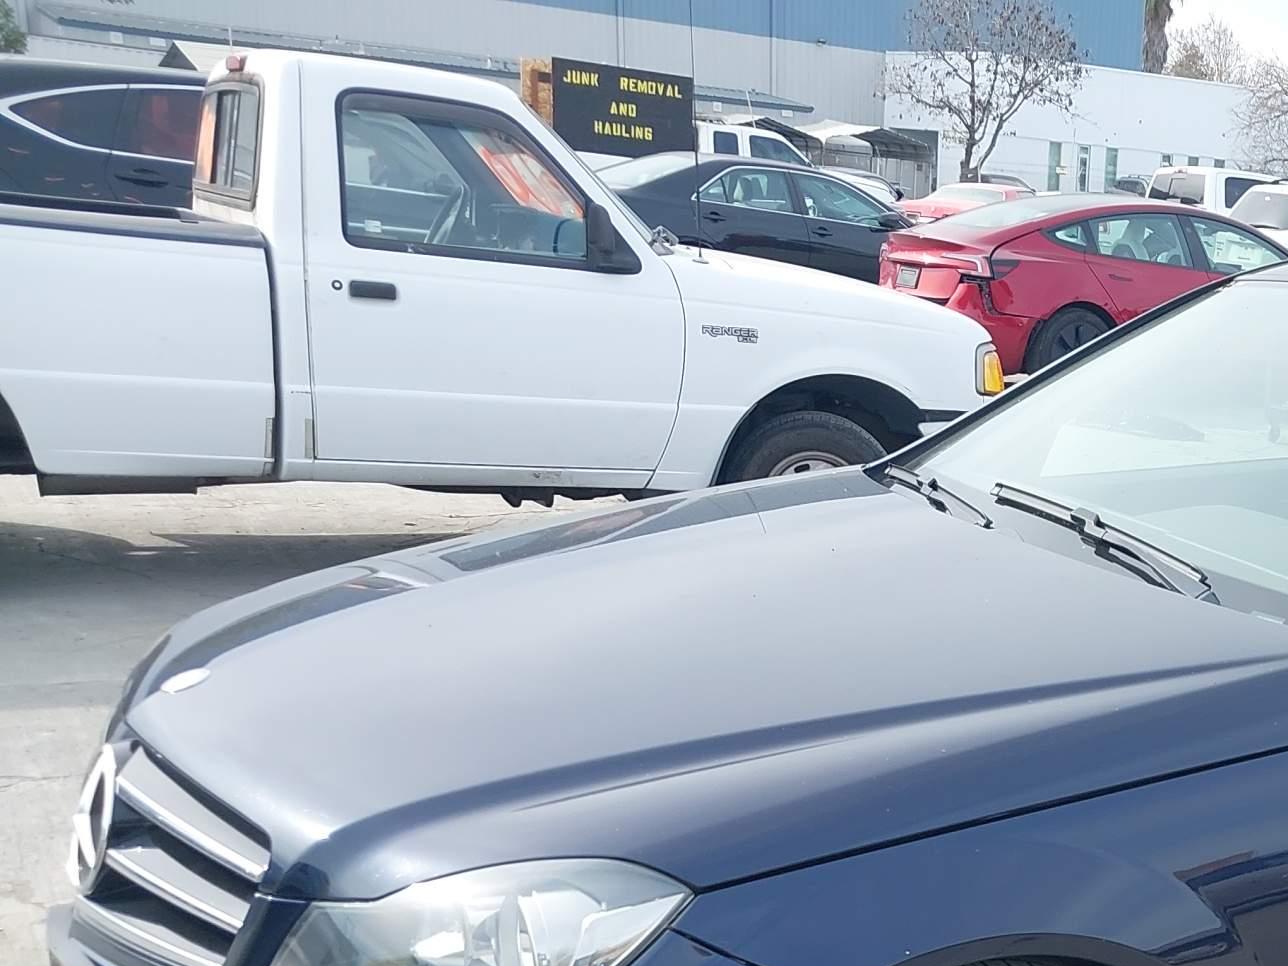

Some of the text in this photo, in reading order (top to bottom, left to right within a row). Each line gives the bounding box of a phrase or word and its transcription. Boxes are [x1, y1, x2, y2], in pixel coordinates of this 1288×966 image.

[563, 69, 682, 98] JUNK REMOVAL
[609, 101, 637, 118] AND
[593, 120, 653, 141] HAULING
